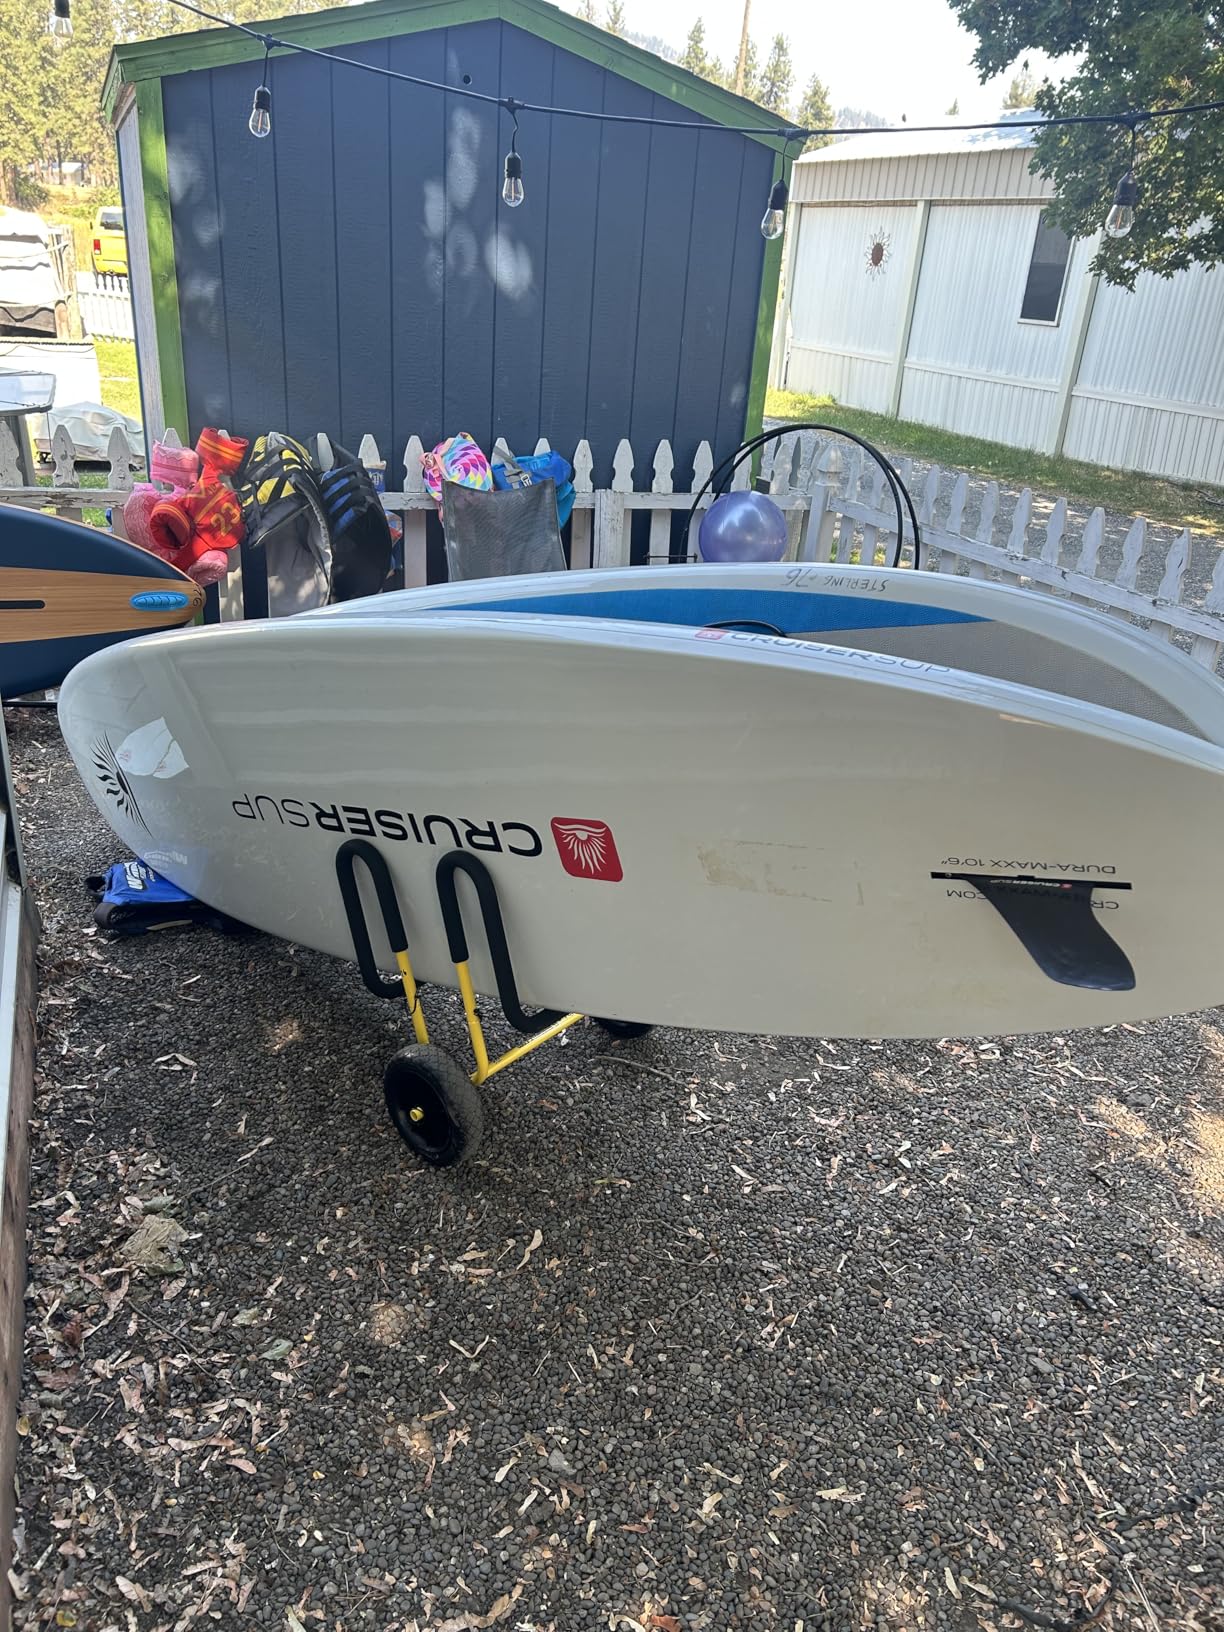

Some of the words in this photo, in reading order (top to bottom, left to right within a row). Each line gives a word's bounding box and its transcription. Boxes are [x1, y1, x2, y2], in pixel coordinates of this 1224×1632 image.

[210, 501, 241, 537] 23
[823, 575, 889, 592] STERLING
[729, 631, 951, 674] CRUISERSUP
[231, 793, 543, 857] CRUISERSUP
[991, 859, 1116, 875] DURA-MAXX
